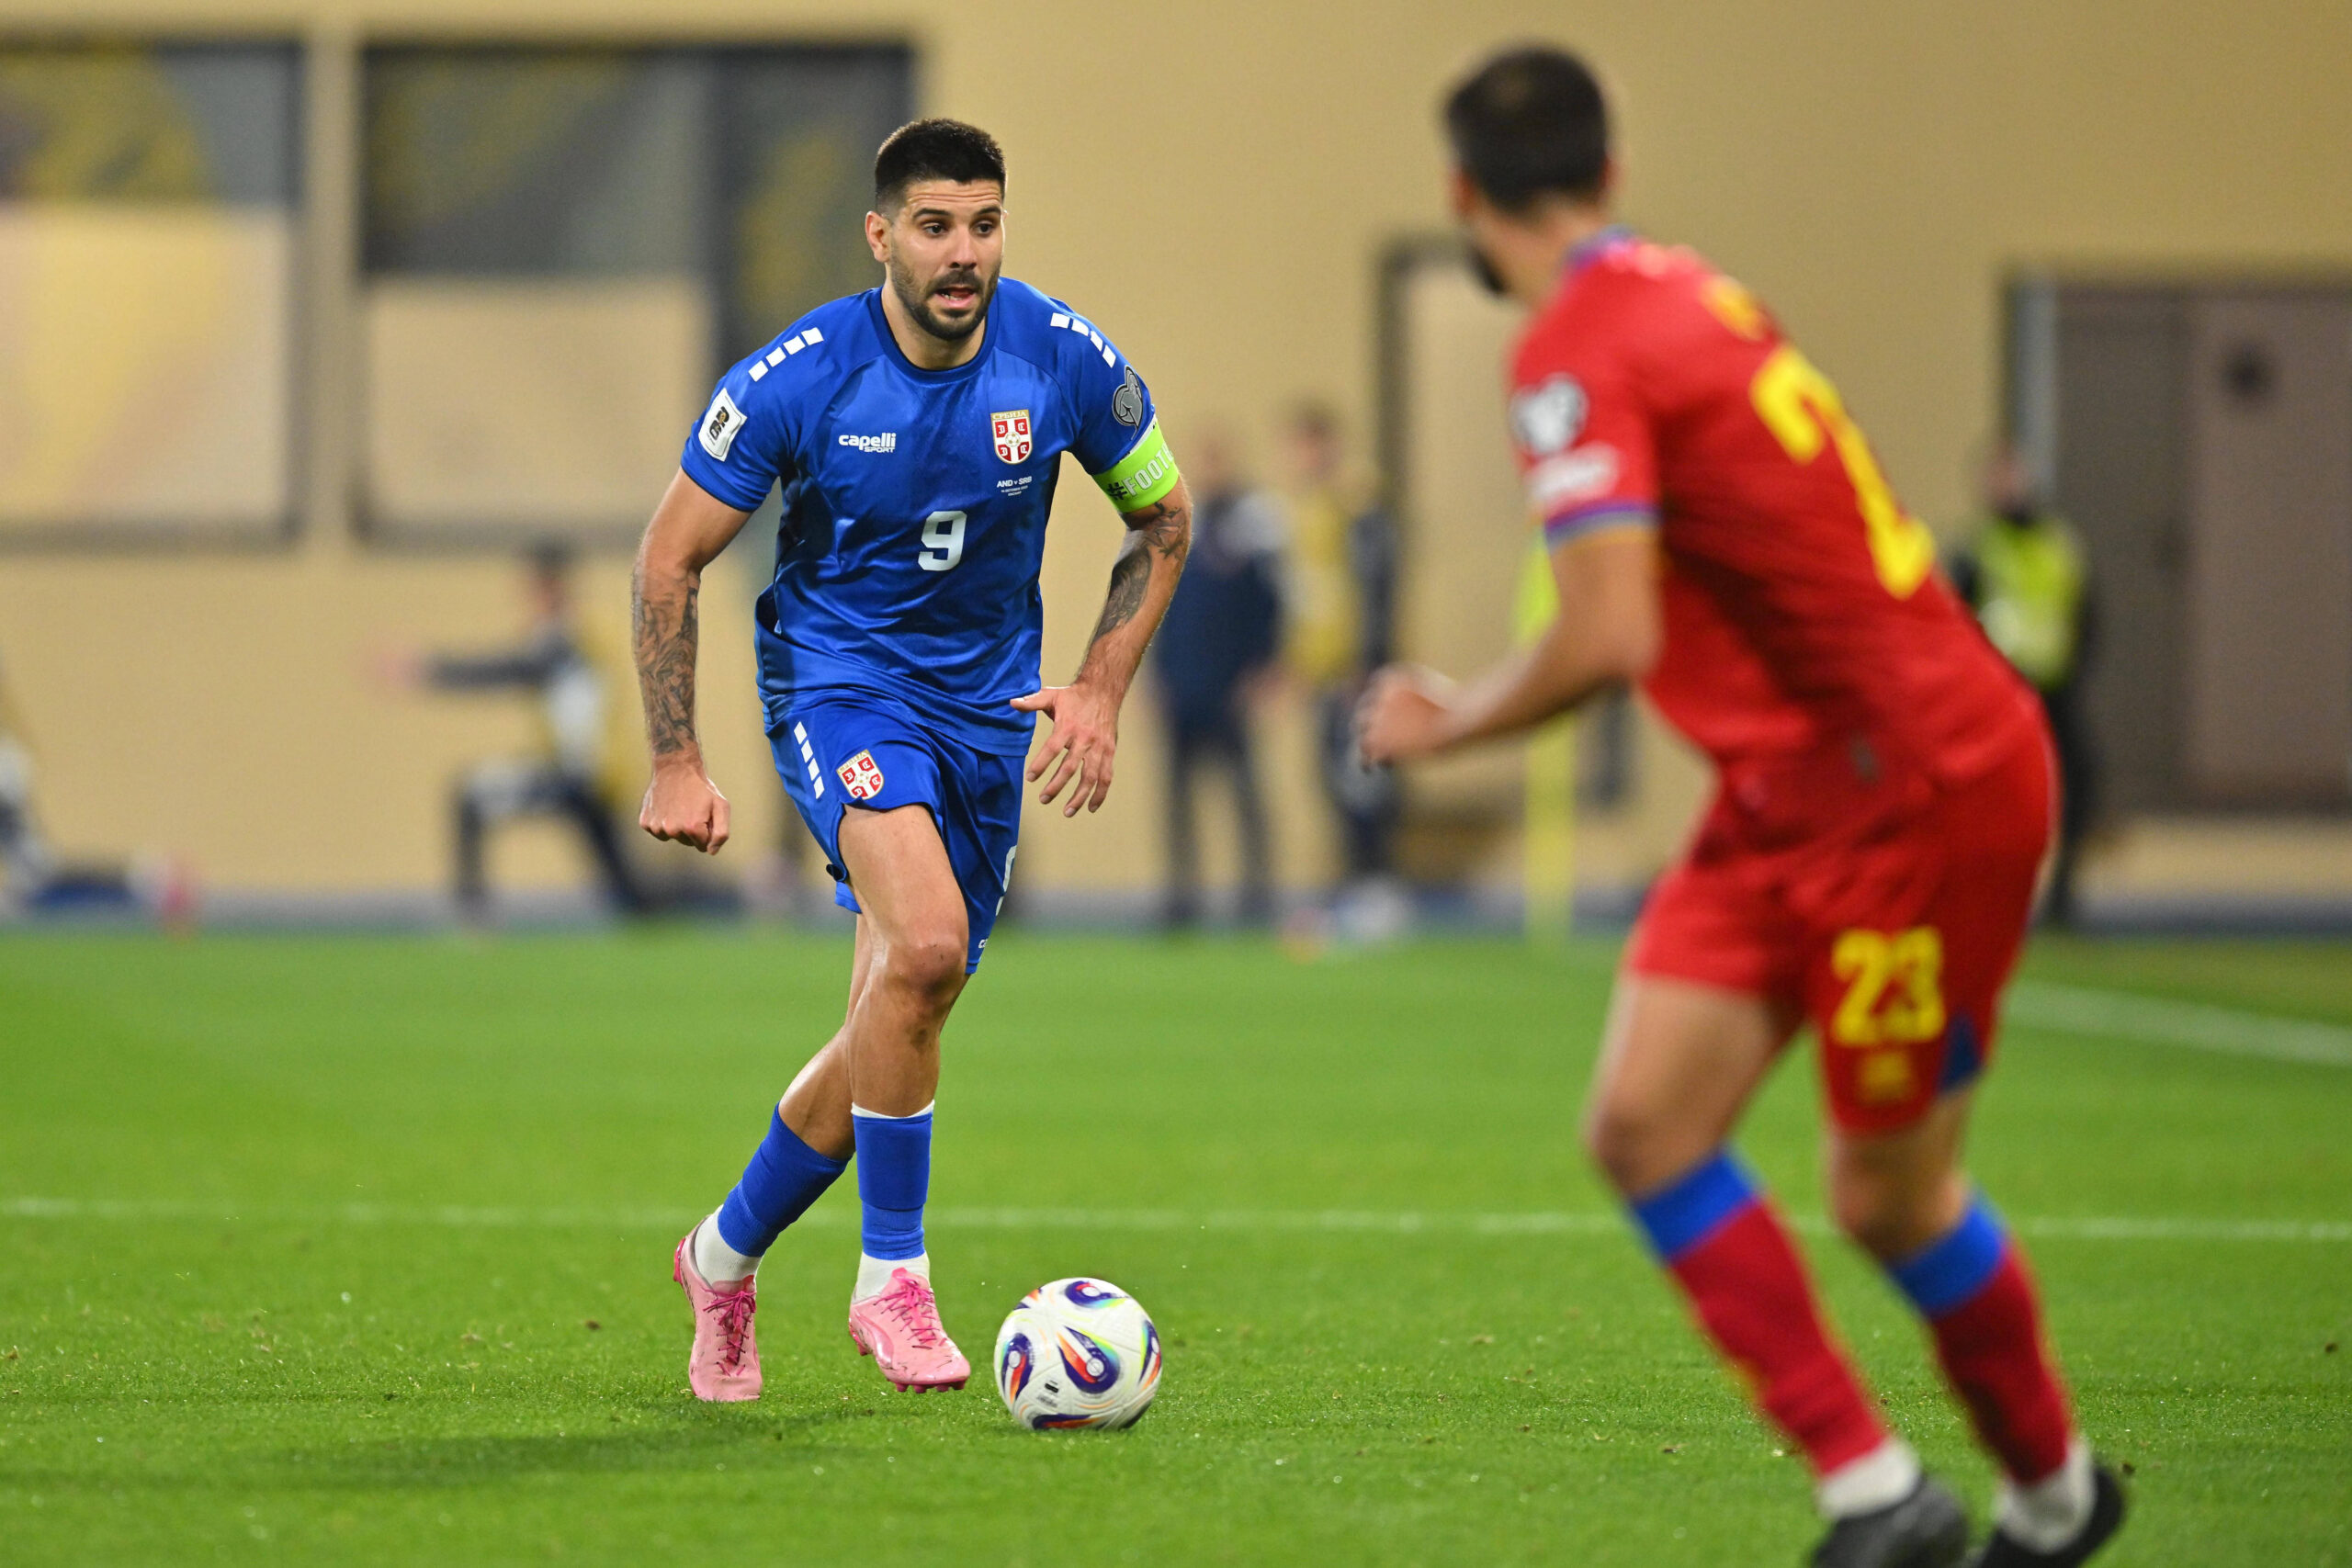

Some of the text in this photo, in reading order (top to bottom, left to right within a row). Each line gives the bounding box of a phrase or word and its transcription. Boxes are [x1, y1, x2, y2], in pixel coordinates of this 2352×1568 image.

[838, 432, 897, 451] capelli
[996, 479, 1013, 488] AND
[1018, 476, 1033, 485] SRB
[917, 510, 968, 571] 9
[1832, 925, 1945, 1044] 23
